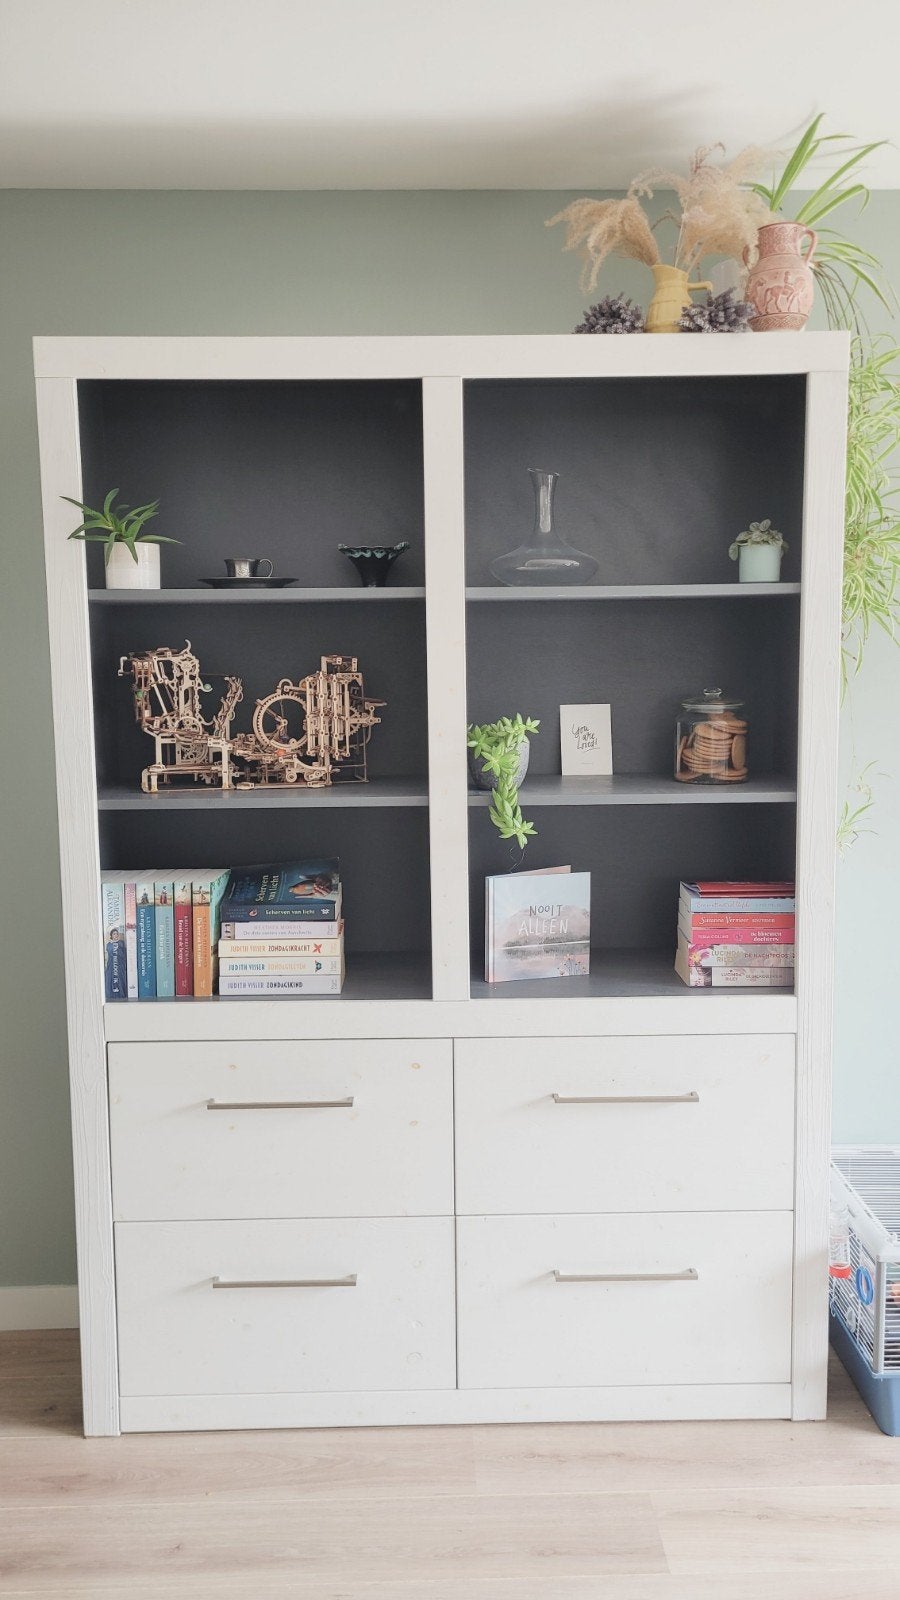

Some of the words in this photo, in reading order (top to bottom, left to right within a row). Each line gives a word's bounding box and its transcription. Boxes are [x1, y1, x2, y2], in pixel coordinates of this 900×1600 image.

[572, 724, 589, 738] You
[582, 732, 595, 741] are
[256, 875, 268, 902] Scherven
[529, 904, 563, 917] NOOIT
[518, 918, 568, 936] ALLEEN
